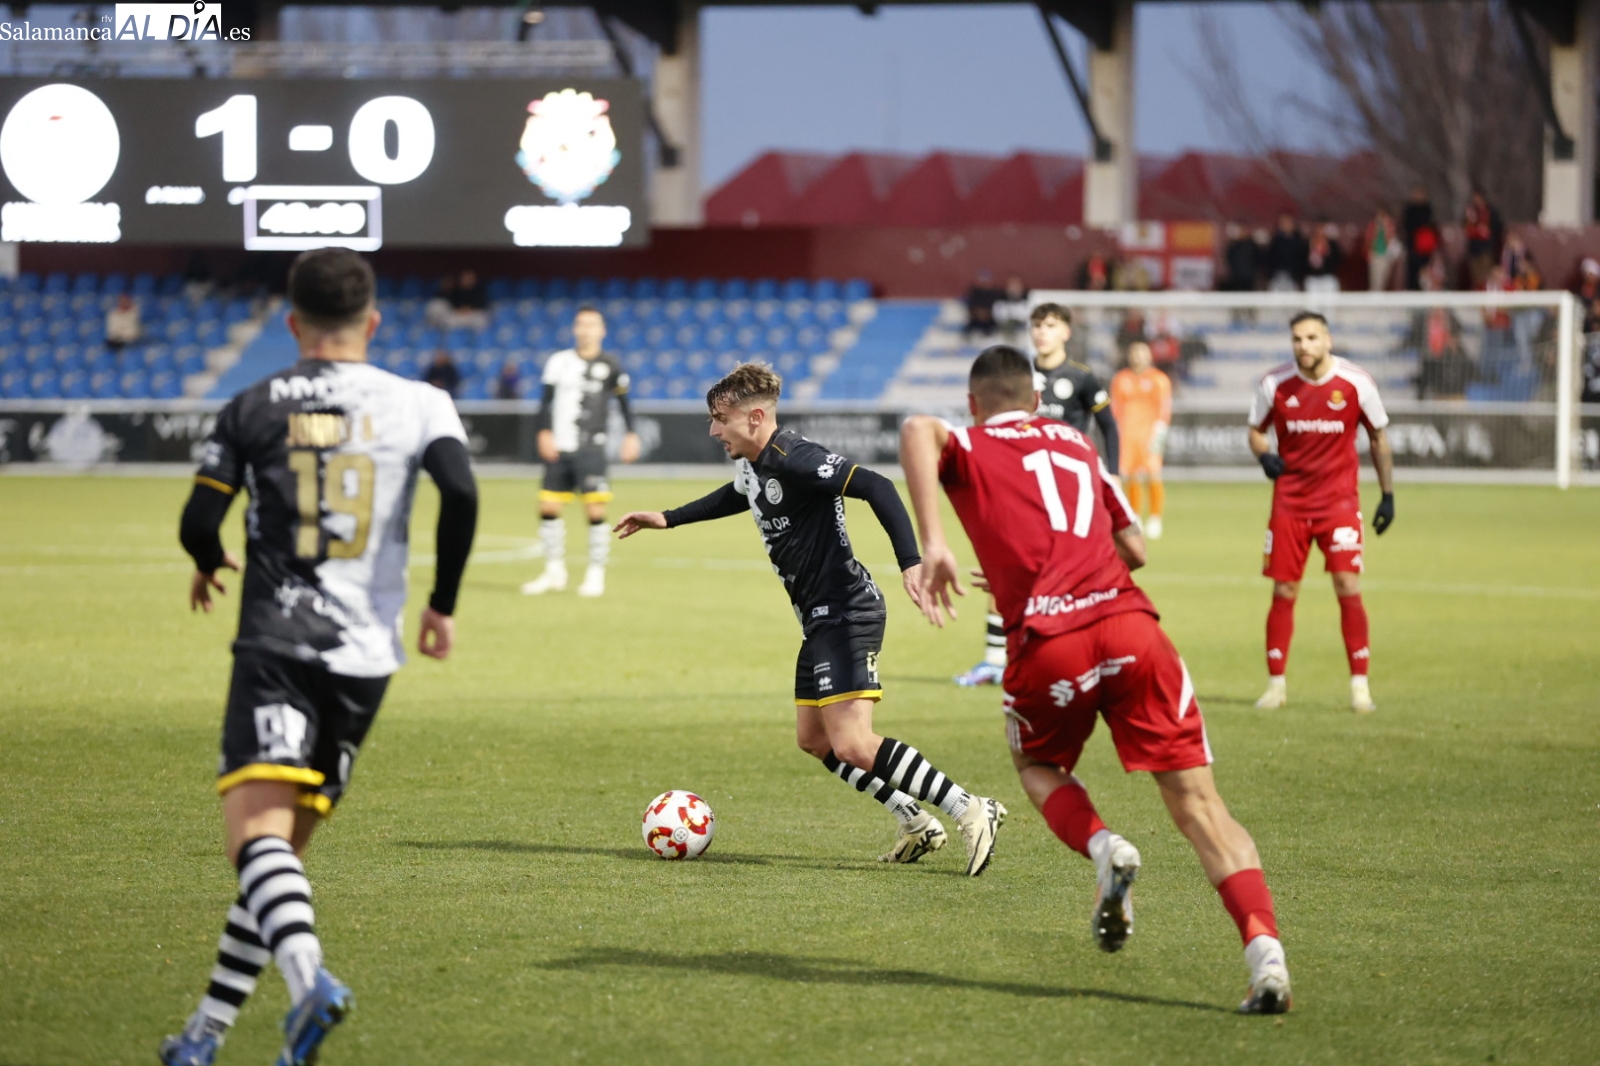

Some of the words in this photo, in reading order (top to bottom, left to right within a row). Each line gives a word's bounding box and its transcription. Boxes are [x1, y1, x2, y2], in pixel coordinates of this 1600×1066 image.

[195, 94, 258, 183] 1
[348, 95, 436, 185] 0
[288, 451, 375, 560] 19
[1021, 448, 1095, 539] 17
